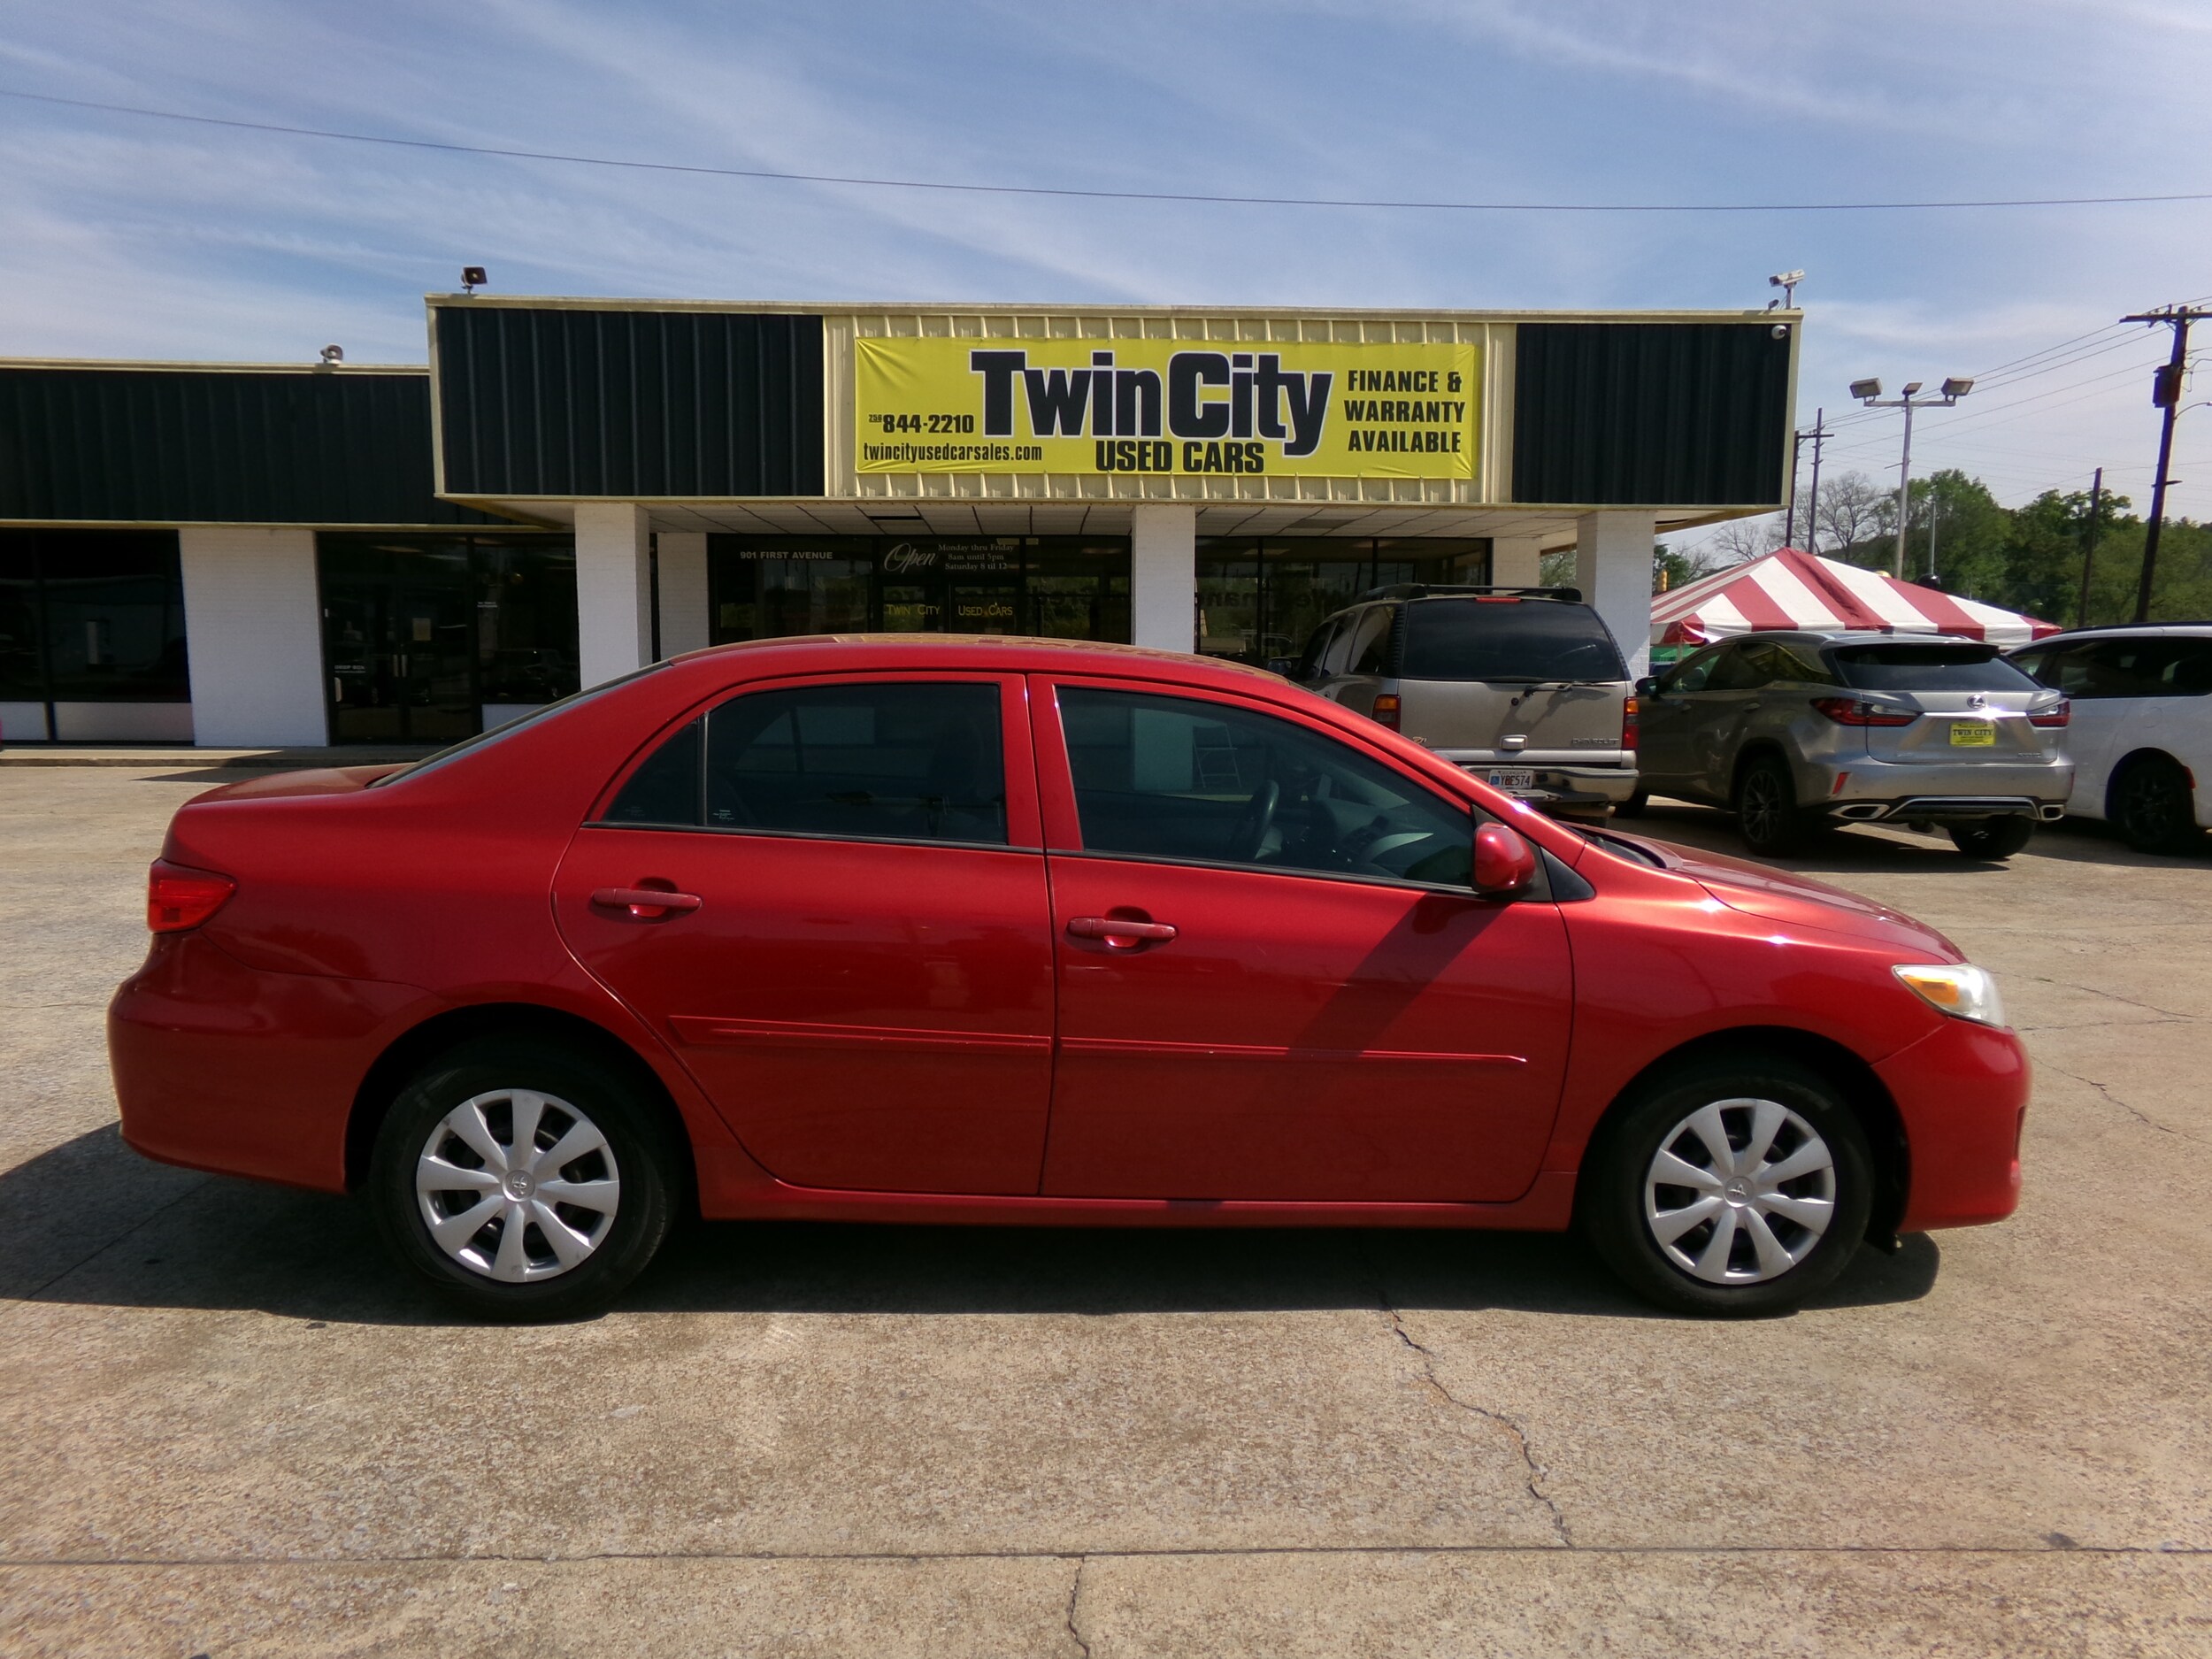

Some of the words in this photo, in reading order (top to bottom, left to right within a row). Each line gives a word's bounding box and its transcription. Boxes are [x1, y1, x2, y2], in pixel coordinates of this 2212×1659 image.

[1348, 370, 1439, 393] FINANCE
[1447, 371, 1463, 393] &
[1343, 399, 1466, 423] WARRANTY
[868, 414, 882, 423] 256
[883, 413, 974, 434] 844-2210
[864, 442, 1042, 463] twincityusedcarsales.com
[1348, 430, 1461, 453] AVAILABLE
[1095, 441, 1172, 472] USED
[1182, 442, 1263, 473] CARS
[884, 542, 937, 573] Open
